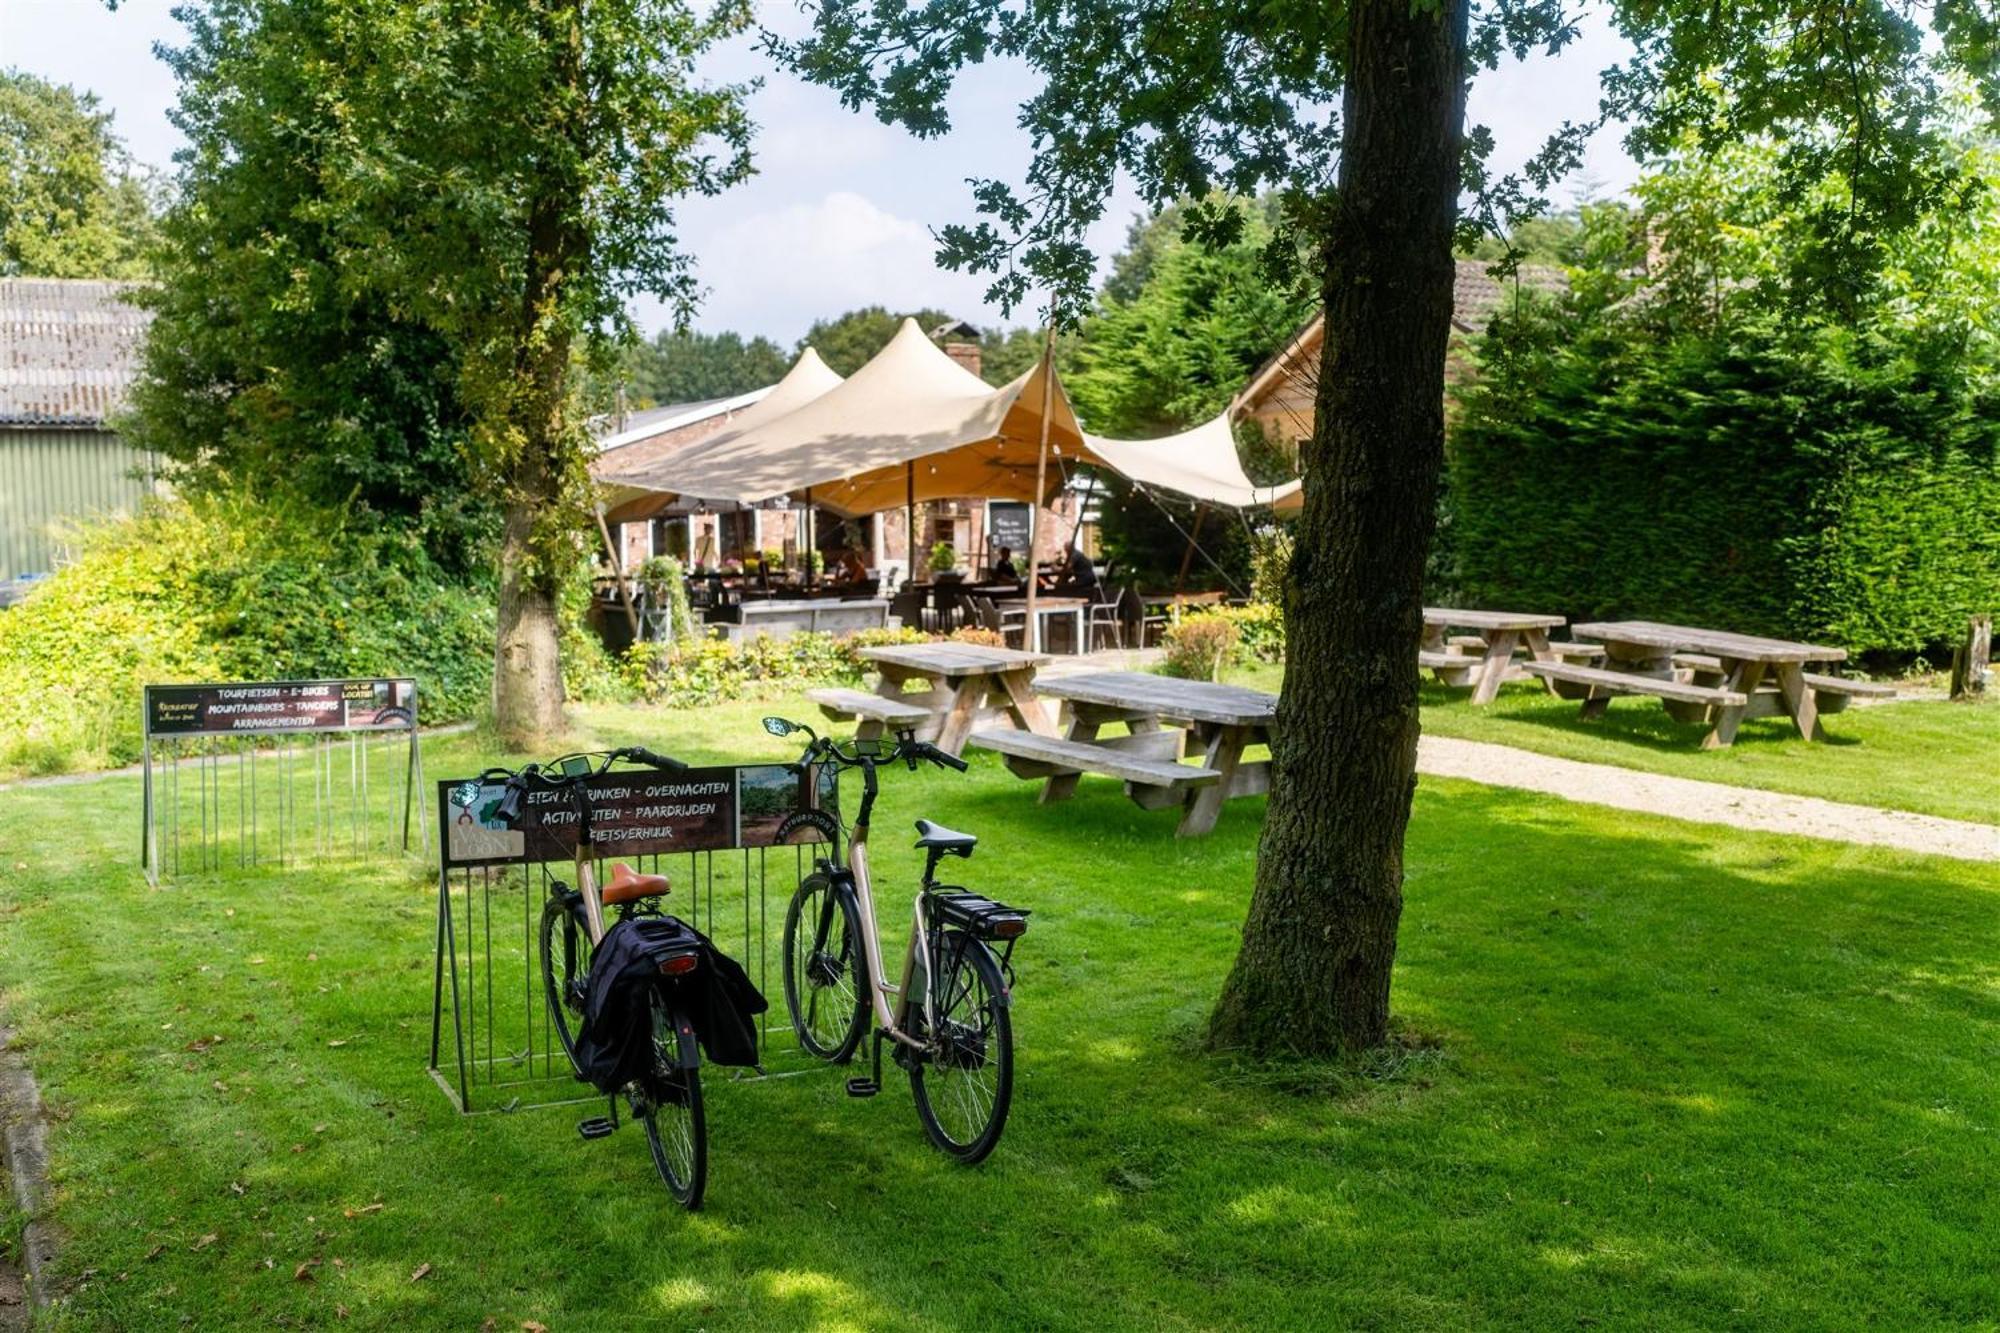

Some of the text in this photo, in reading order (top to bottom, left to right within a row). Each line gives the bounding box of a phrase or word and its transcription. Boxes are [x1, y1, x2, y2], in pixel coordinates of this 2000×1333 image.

[217, 687, 280, 699] TOURFIETSEN
[291, 686, 330, 696] E-BIKES
[208, 703, 285, 715] MOUNTAINBIKES
[296, 701, 338, 712] TANDEMS
[233, 717, 316, 728] ARRANGEMENTEN
[527, 791, 560, 805] ETEN
[586, 787, 631, 801] RINKEN
[645, 782, 729, 797] OVERNACHTEN
[635, 803, 716, 819] PAARDRIJDEN
[589, 826, 673, 842] FIETSVERHUUR
